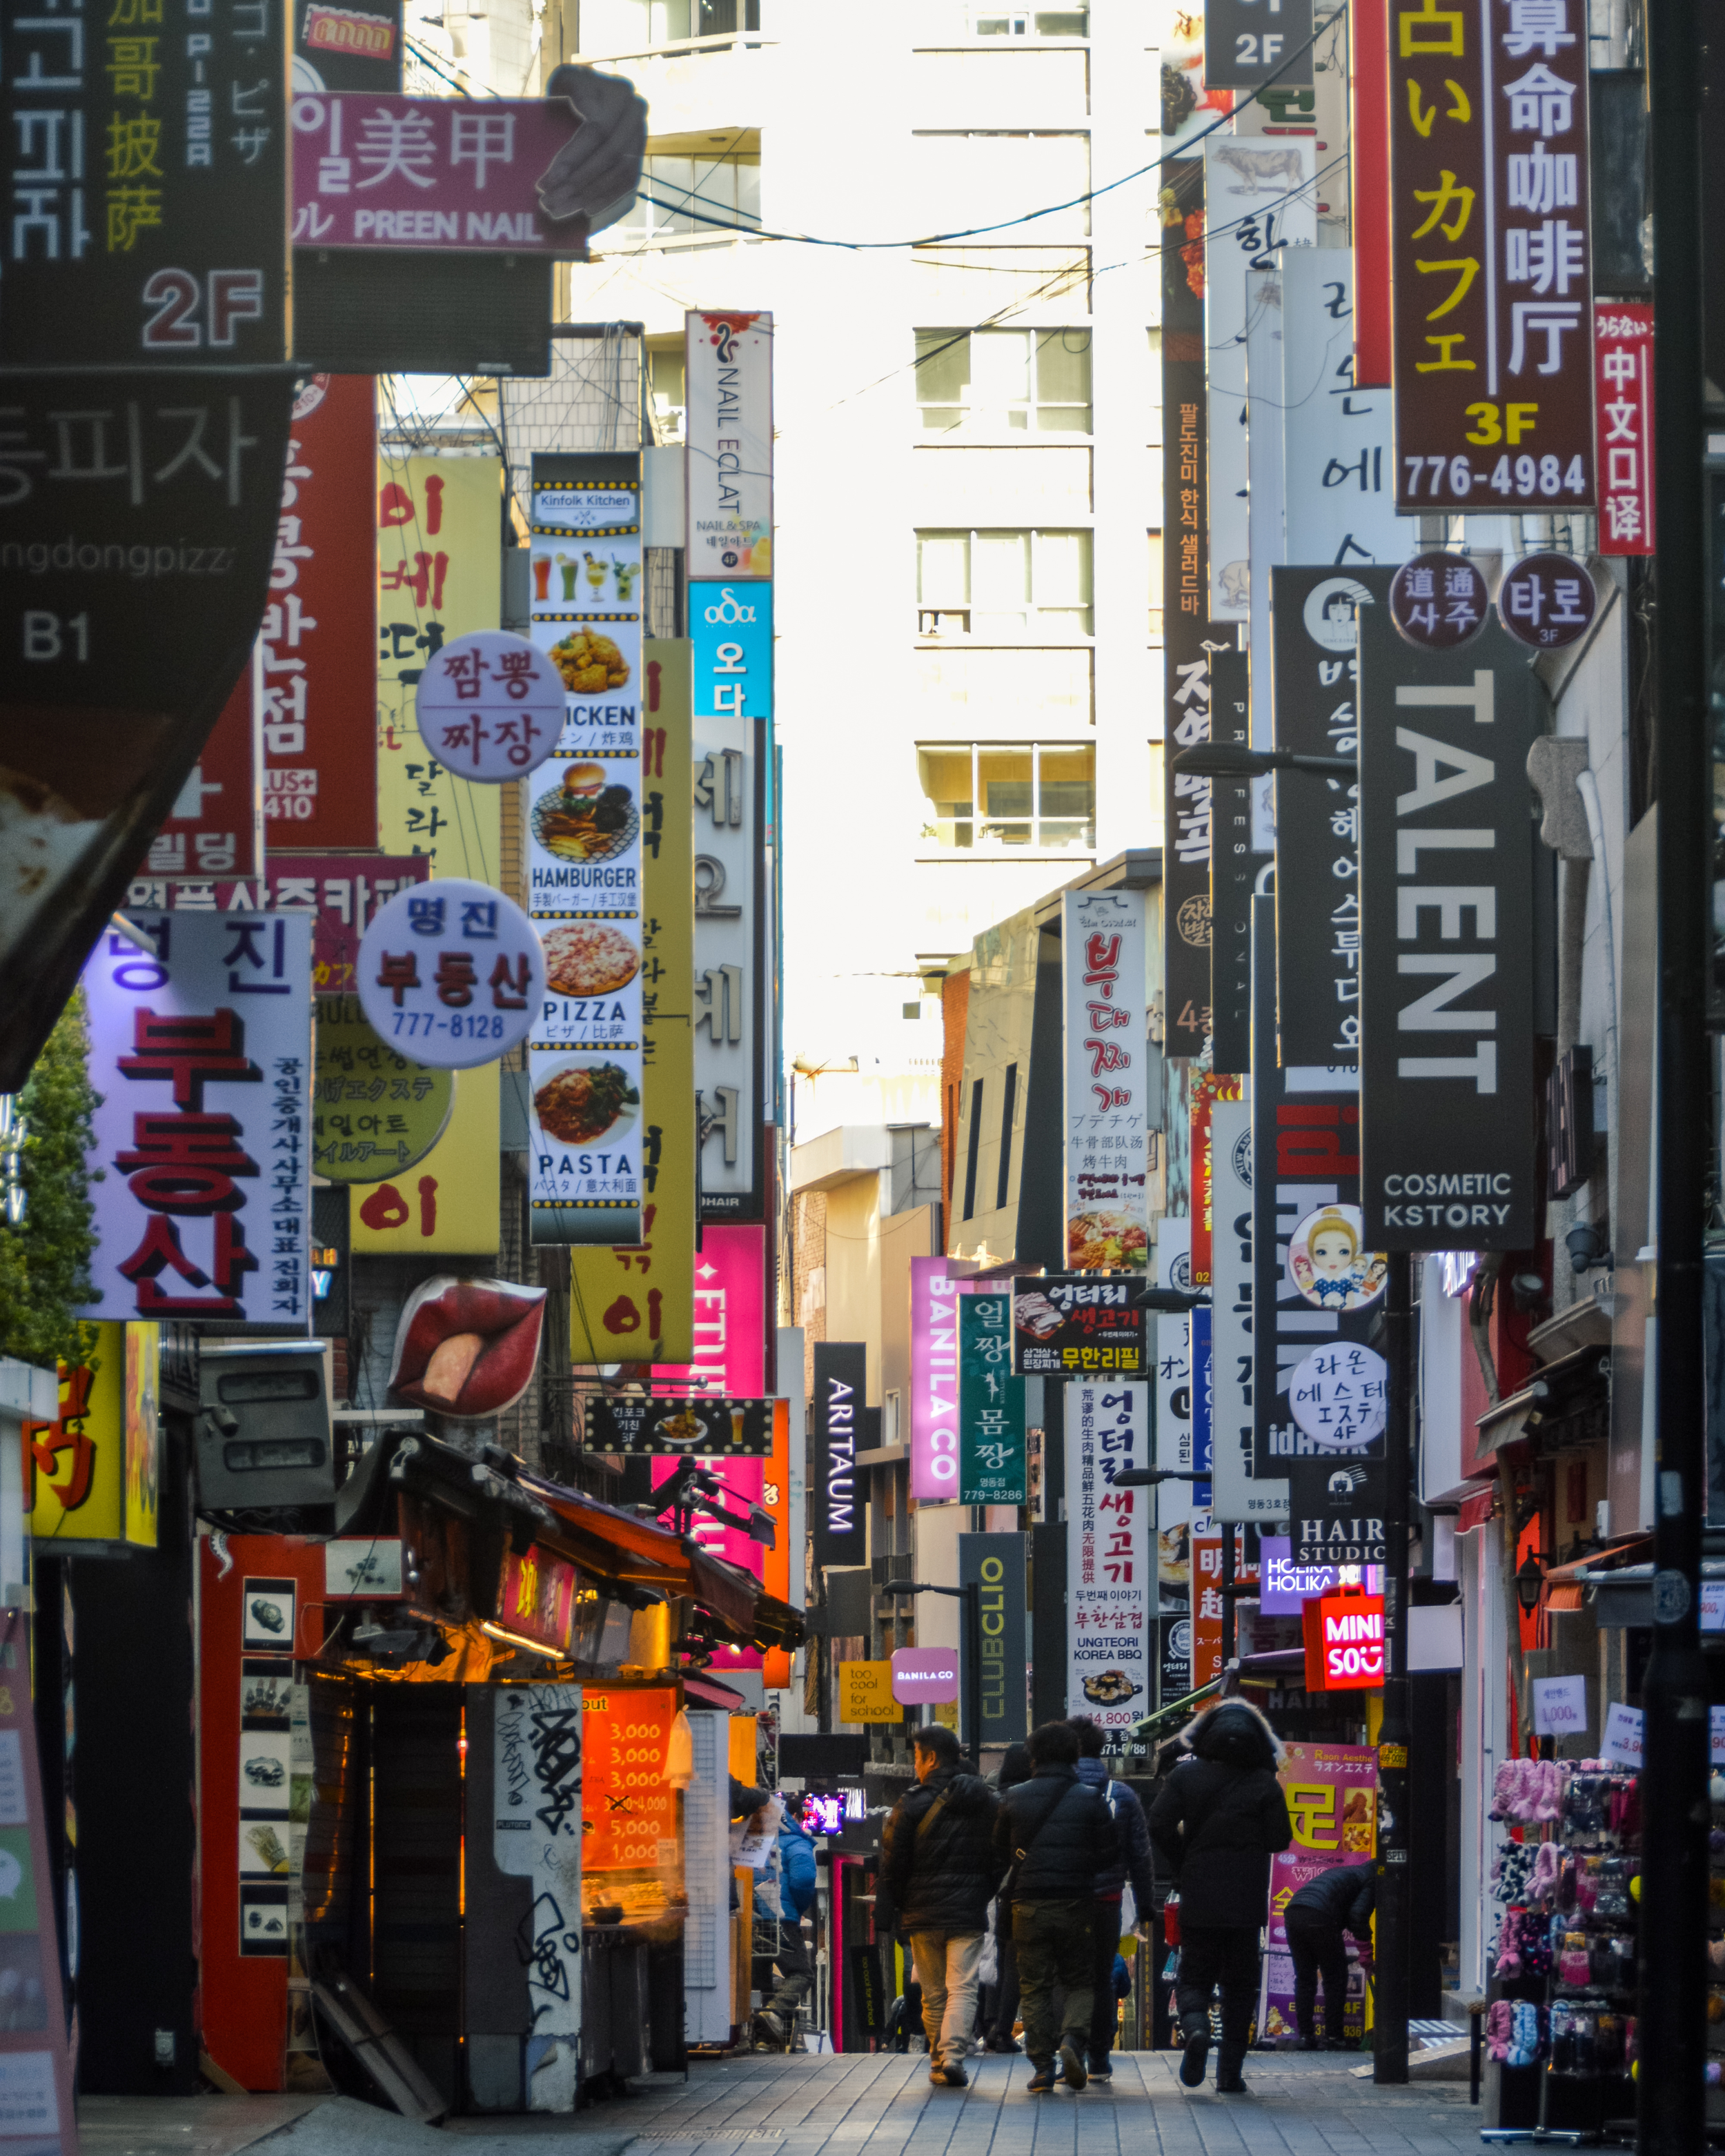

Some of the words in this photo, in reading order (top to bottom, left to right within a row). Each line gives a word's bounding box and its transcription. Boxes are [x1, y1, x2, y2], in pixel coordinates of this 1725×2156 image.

[1235, 34, 1284, 63] 2F
[355, 107, 517, 190] 美甲
[355, 209, 457, 240] PREEN
[467, 212, 544, 241] NAIL
[143, 268, 264, 348] 2F
[1464, 402, 1539, 445] 3F
[1603, 346, 1641, 542] 中文口译
[1404, 454, 1585, 496] 776-4984
[540, 495, 583, 506] Kinfolk
[586, 495, 630, 506] Kitchen
[1179, 488, 1200, 530] 한식
[1179, 534, 1200, 615] 샐러드바
[1510, 574, 1586, 626] 타로
[1405, 600, 1479, 635] 사주
[23, 610, 91, 662] B1
[1539, 629, 1559, 643] 3F
[443, 646, 540, 700] 짬뽕
[441, 713, 542, 766] 짜장
[532, 867, 636, 888] HAMBURGER
[1395, 669, 1497, 1094] TALENT
[406, 898, 498, 940] 명진
[375, 949, 533, 1010] 부동산
[543, 1001, 627, 1021] PIZZA
[1082, 931, 1131, 1112] 부대찌개
[393, 1011, 504, 1038] 777-8128
[1071, 1136, 1143, 1149] 牛骨部队汤
[112, 1007, 265, 1320] 부동산
[539, 1154, 632, 1174] PASTA
[1082, 1154, 1127, 1169] 烤牛肉
[1383, 1174, 1511, 1196] COSMETIC
[1383, 1204, 1511, 1228] KSTORY
[1049, 1284, 1127, 1310] 엉터리
[1070, 1307, 1139, 1334] 생고기
[929, 1275, 956, 1418] BANILA
[1062, 1346, 1139, 1369] 무한리필
[1333, 1425, 1357, 1440] 4F
[828, 1377, 854, 1532] ARITAUM
[929, 1427, 957, 1481] CO
[964, 1490, 1023, 1501] 779-8286
[1300, 1519, 1386, 1543] HAIR
[1076, 1590, 1108, 1602] 두번째
[1110, 1590, 1142, 1602] 이야기
[1326, 1614, 1381, 1641] MINI
[1077, 1636, 1138, 1648] UNGTEORI
[1073, 1650, 1114, 1661] KOREA
[1117, 1650, 1143, 1661] BBQ
[850, 1668, 871, 1679] too
[850, 1678, 878, 1690] cool
[897, 1672, 937, 1680] BANILA
[938, 1670, 954, 1679] CO
[850, 1693, 867, 1704] for
[850, 1704, 894, 1717] school
[610, 1723, 661, 1741] 3,000
[610, 1747, 661, 1766] 3,000
[610, 1772, 661, 1790] 3,000
[611, 1819, 661, 1837] 5,000
[612, 1843, 657, 1862] 1,000
